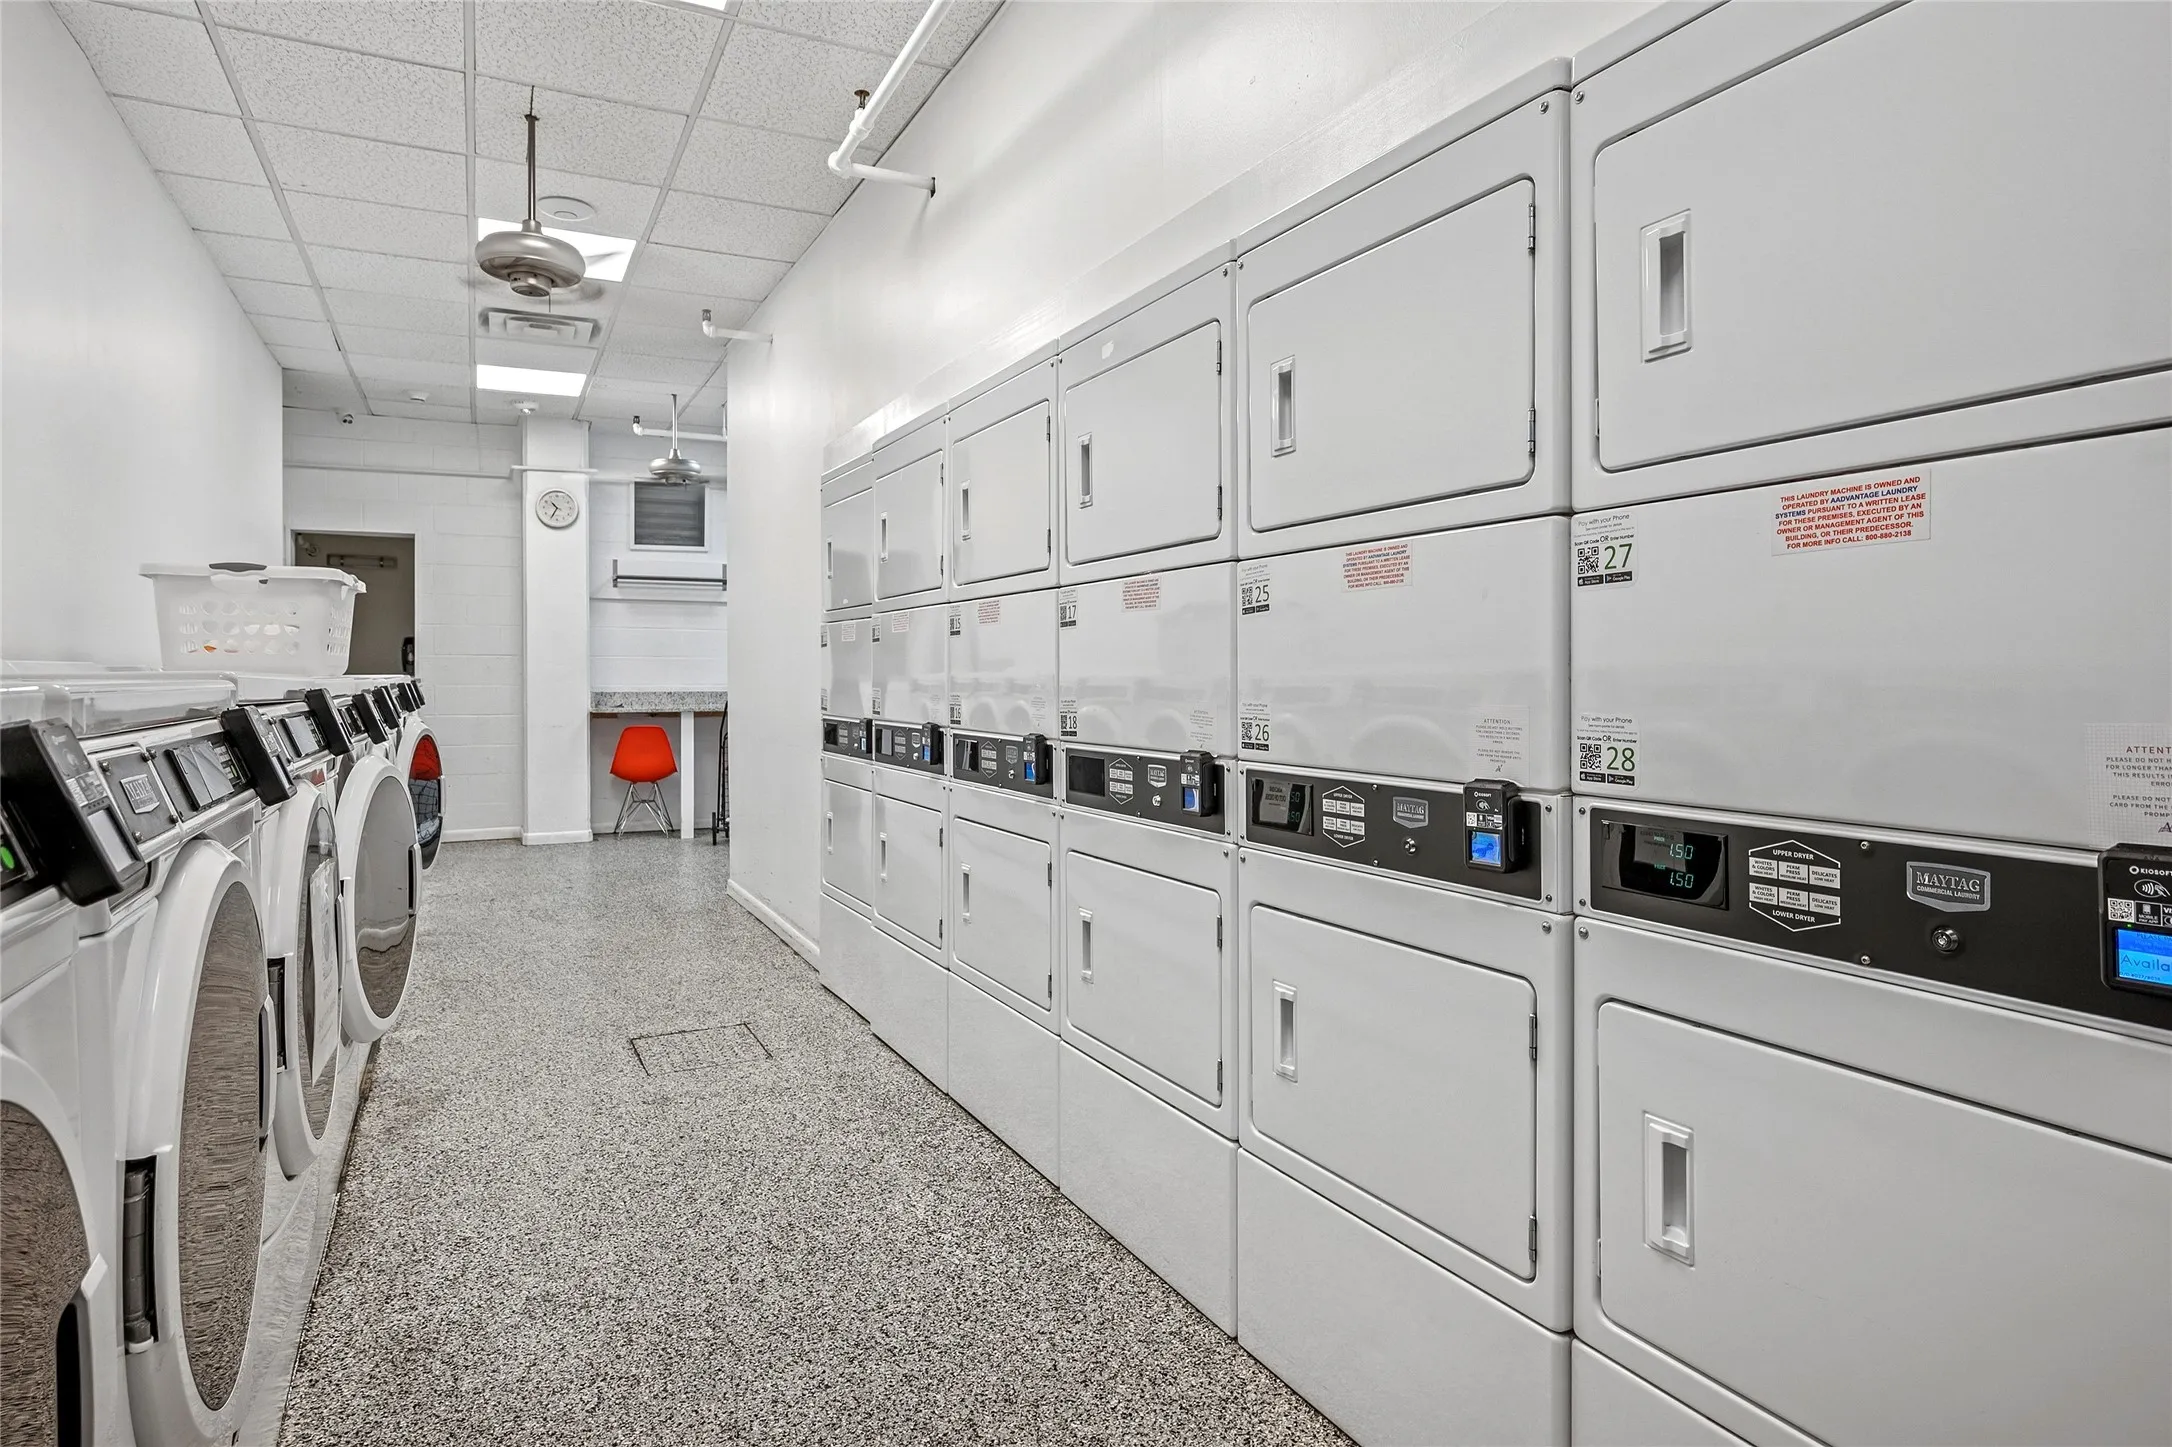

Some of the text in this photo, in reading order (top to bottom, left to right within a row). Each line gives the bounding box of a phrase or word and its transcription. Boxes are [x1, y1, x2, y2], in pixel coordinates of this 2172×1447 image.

[1797, 490, 1829, 501] LAUNDRY
[1830, 485, 1863, 495] MACHINE
[1874, 479, 1902, 489] OWNED
[1904, 476, 1920, 484] AND
[1782, 500, 1818, 510] OPERATED
[1830, 491, 1879, 503] AADVANTAGE
[1881, 485, 1918, 496] LAUNDRY
[1775, 510, 1806, 519] SYSTEMS
[1808, 505, 1845, 514] PURSUANT
[1866, 497, 1898, 507] WRITTEN
[1901, 493, 1926, 502] LEASE
[1857, 506, 1896, 516] EXECUTED
[1777, 527, 1800, 535] OWNER
[1815, 518, 1864, 530] MANAGEMENT
[1867, 515, 1892, 524] AGENT
[1833, 528, 1853, 536] THEIR
[1856, 522, 1913, 533] PREDECESSOR.
[1803, 540, 1822, 548] MORE
[1866, 530, 1911, 541] 800-880-2138
[1604, 543, 1632, 569] 27
[1255, 585, 1269, 603] 25
[1068, 605, 1076, 619] 17
[1069, 716, 1077, 729] 18
[1255, 724, 1269, 741] 26
[1607, 746, 1635, 772] 28
[1670, 844, 1693, 859] 1.50
[1773, 849, 1814, 860] UPPER DRYER
[1670, 872, 1693, 888] 1.50
[1812, 870, 1837, 878] DELICATES
[1916, 872, 1980, 892] MAYTAG
[1917, 886, 1980, 900] COMMERCIAL LAUNDRY
[1812, 898, 1837, 906] DELICATES
[1773, 910, 1815, 922] LOWER DRYER
[2121, 954, 2172, 972] Availa
